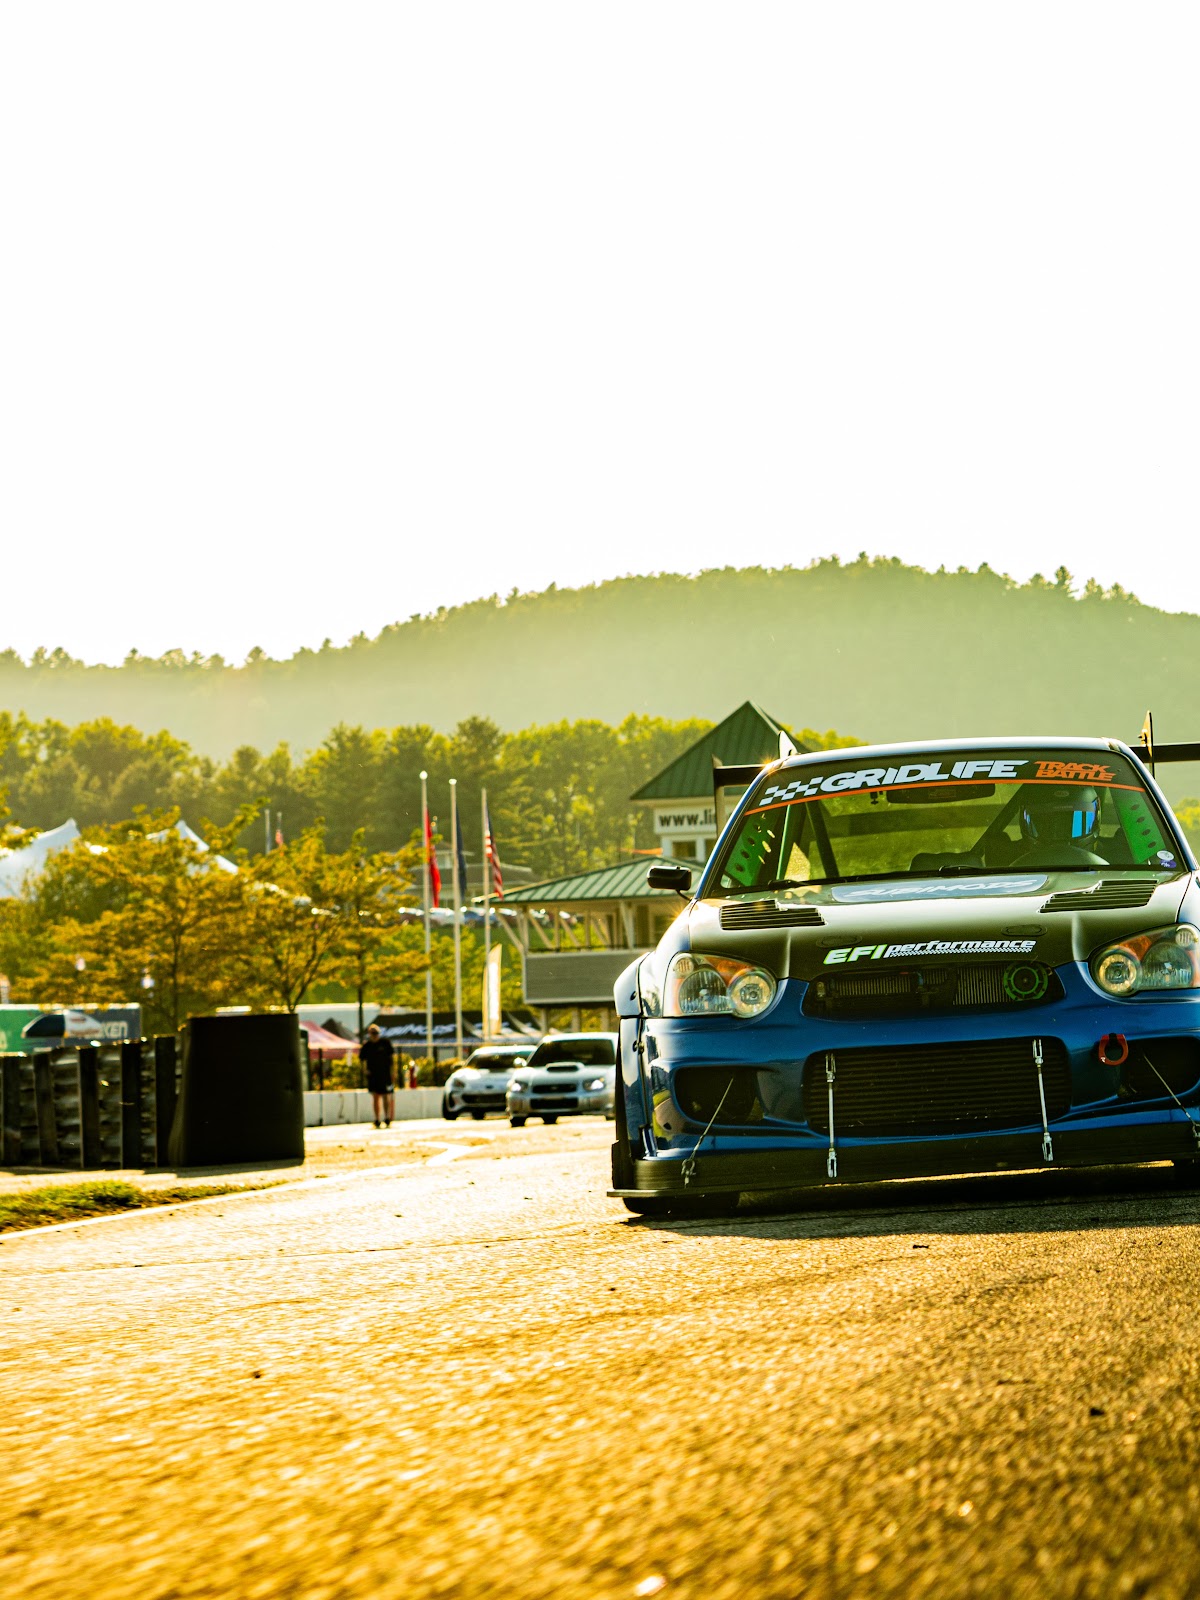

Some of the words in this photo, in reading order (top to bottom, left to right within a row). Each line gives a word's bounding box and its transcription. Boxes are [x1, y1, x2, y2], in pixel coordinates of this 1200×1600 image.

[819, 760, 1029, 792] GRIDLIFE
[1034, 761, 1111, 773] TRACK
[1036, 769, 1116, 781] BATTLE
[659, 809, 716, 827] www.li
[823, 944, 888, 965] EFI
[884, 940, 1037, 959] performance
